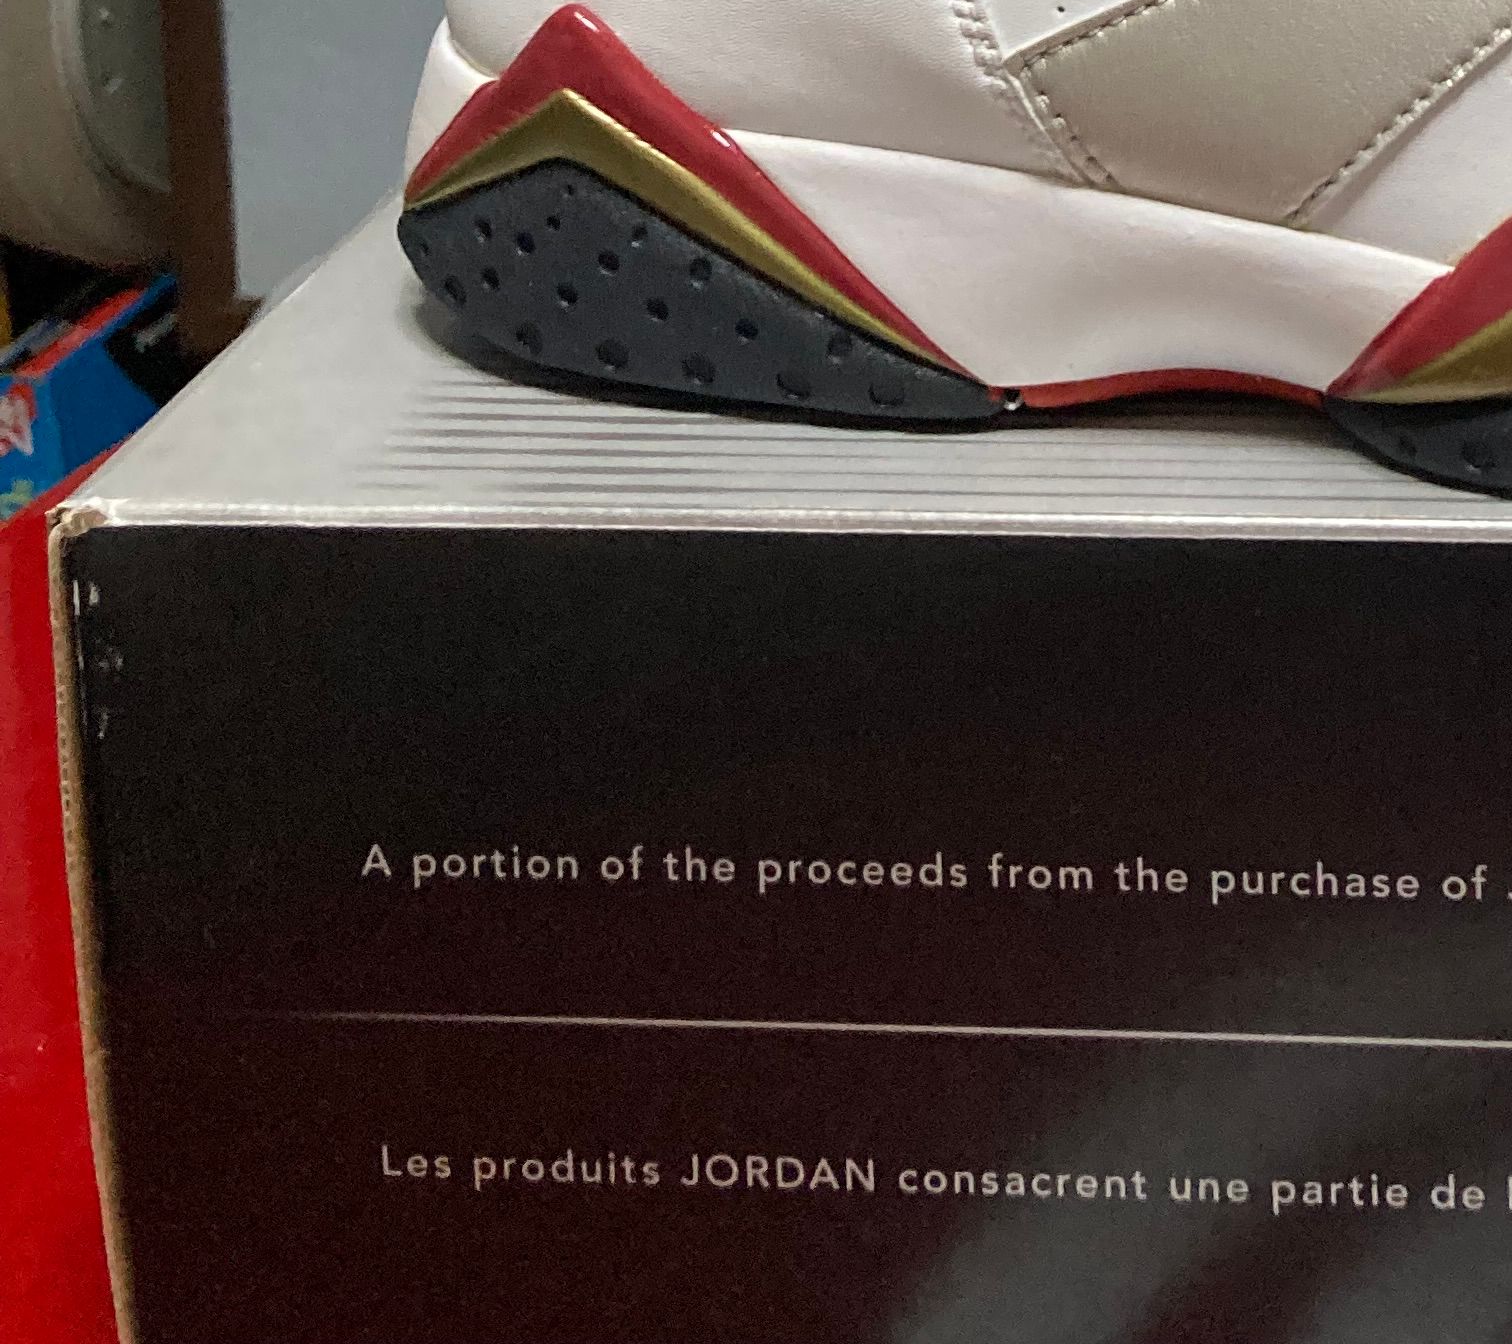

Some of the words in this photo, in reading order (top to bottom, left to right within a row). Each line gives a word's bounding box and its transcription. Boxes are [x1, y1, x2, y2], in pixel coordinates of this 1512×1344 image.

[359, 841, 394, 881] A
[410, 842, 581, 891] portion
[598, 842, 646, 885] of
[661, 843, 738, 886] the
[756, 849, 970, 897] proceeds
[985, 850, 1095, 894] from
[1111, 854, 1190, 895] the
[1208, 858, 1422, 908] purchase
[1439, 862, 1490, 903] of
[379, 1142, 453, 1181] Les
[471, 1146, 662, 1194] produits
[678, 1151, 877, 1195] JORDAN
[896, 1167, 1149, 1203] consacrent
[1167, 1175, 1251, 1206] une
[1269, 1171, 1411, 1218] partie
[1428, 1171, 1487, 1213] de
